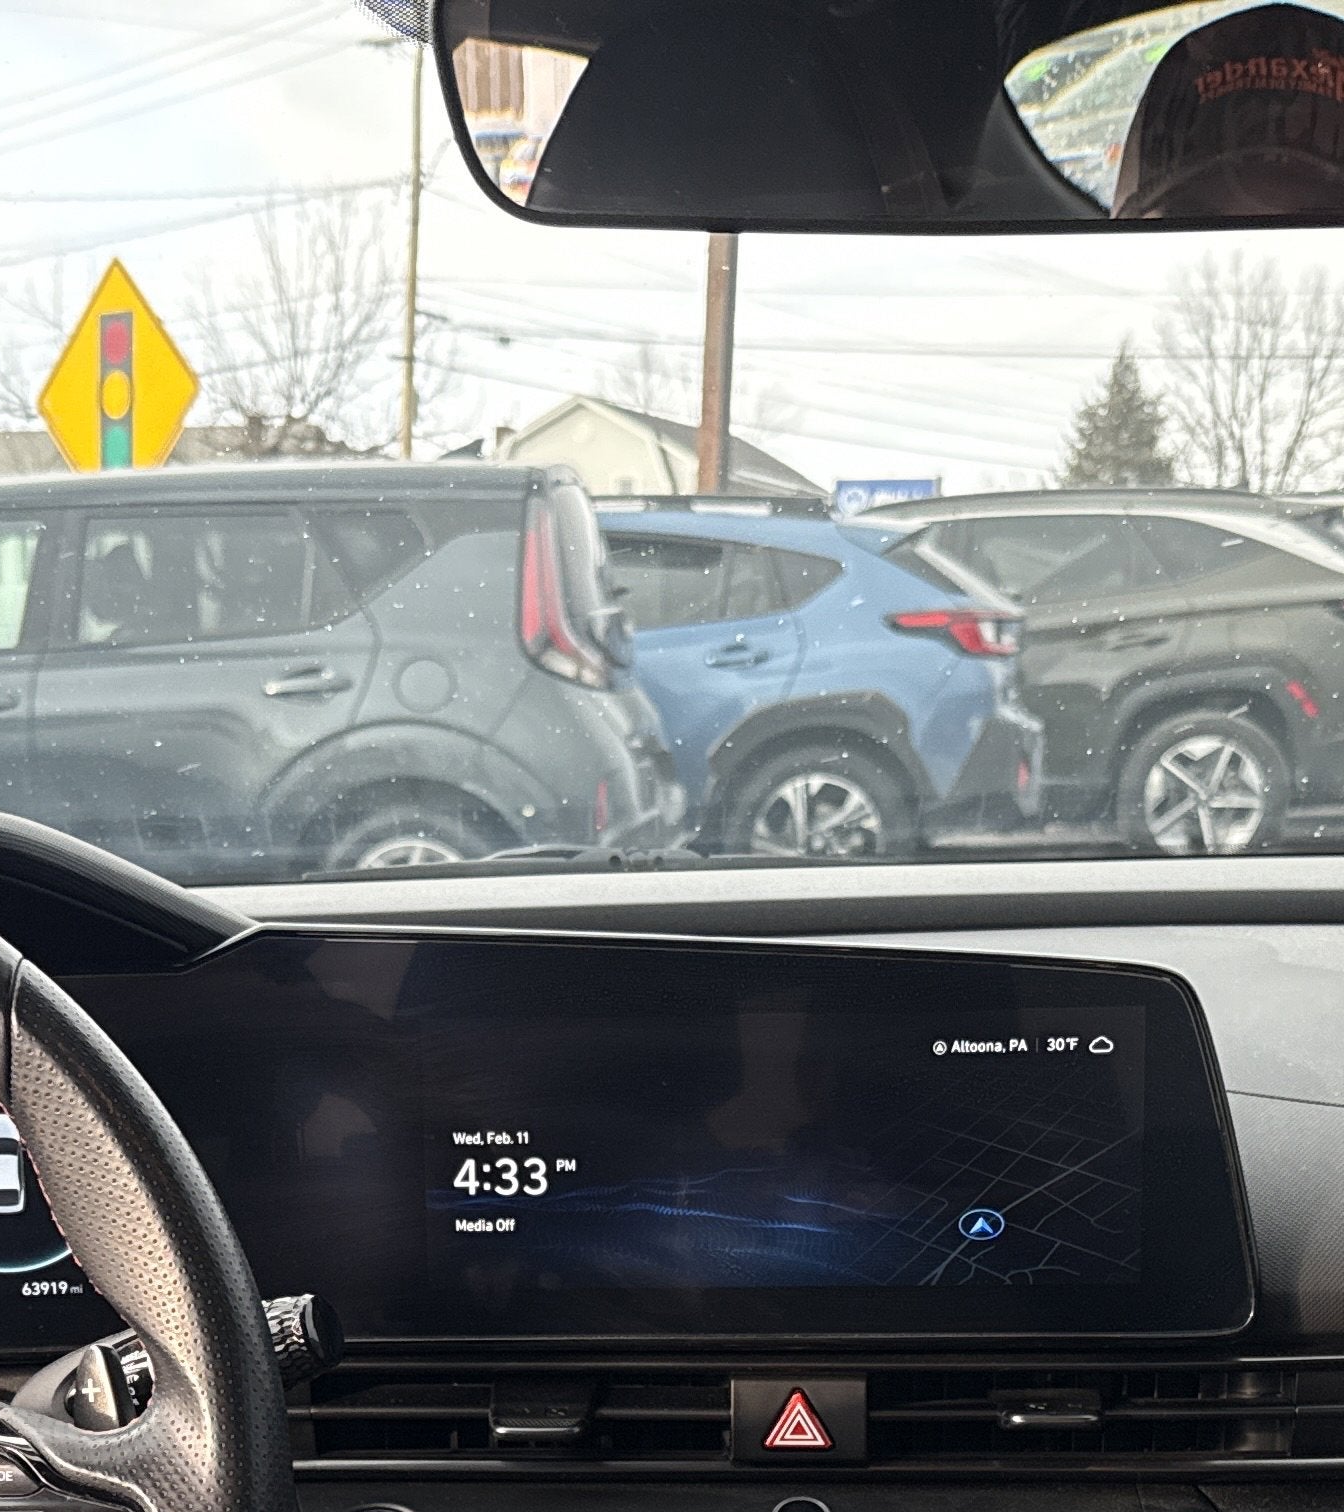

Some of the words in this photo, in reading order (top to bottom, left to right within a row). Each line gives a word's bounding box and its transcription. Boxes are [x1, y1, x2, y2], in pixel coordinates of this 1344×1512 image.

[951, 1038, 1005, 1055] Altoona,
[1008, 1038, 1028, 1053] PA
[453, 1132, 484, 1146] Wed,
[487, 1132, 514, 1145] Feb.
[517, 1131, 529, 1144] 11
[453, 1157, 547, 1196] 4:33
[556, 1159, 576, 1172] PM
[455, 1218, 493, 1232] Media
[496, 1218, 516, 1232] Off
[21, 1281, 68, 1297] 63919
